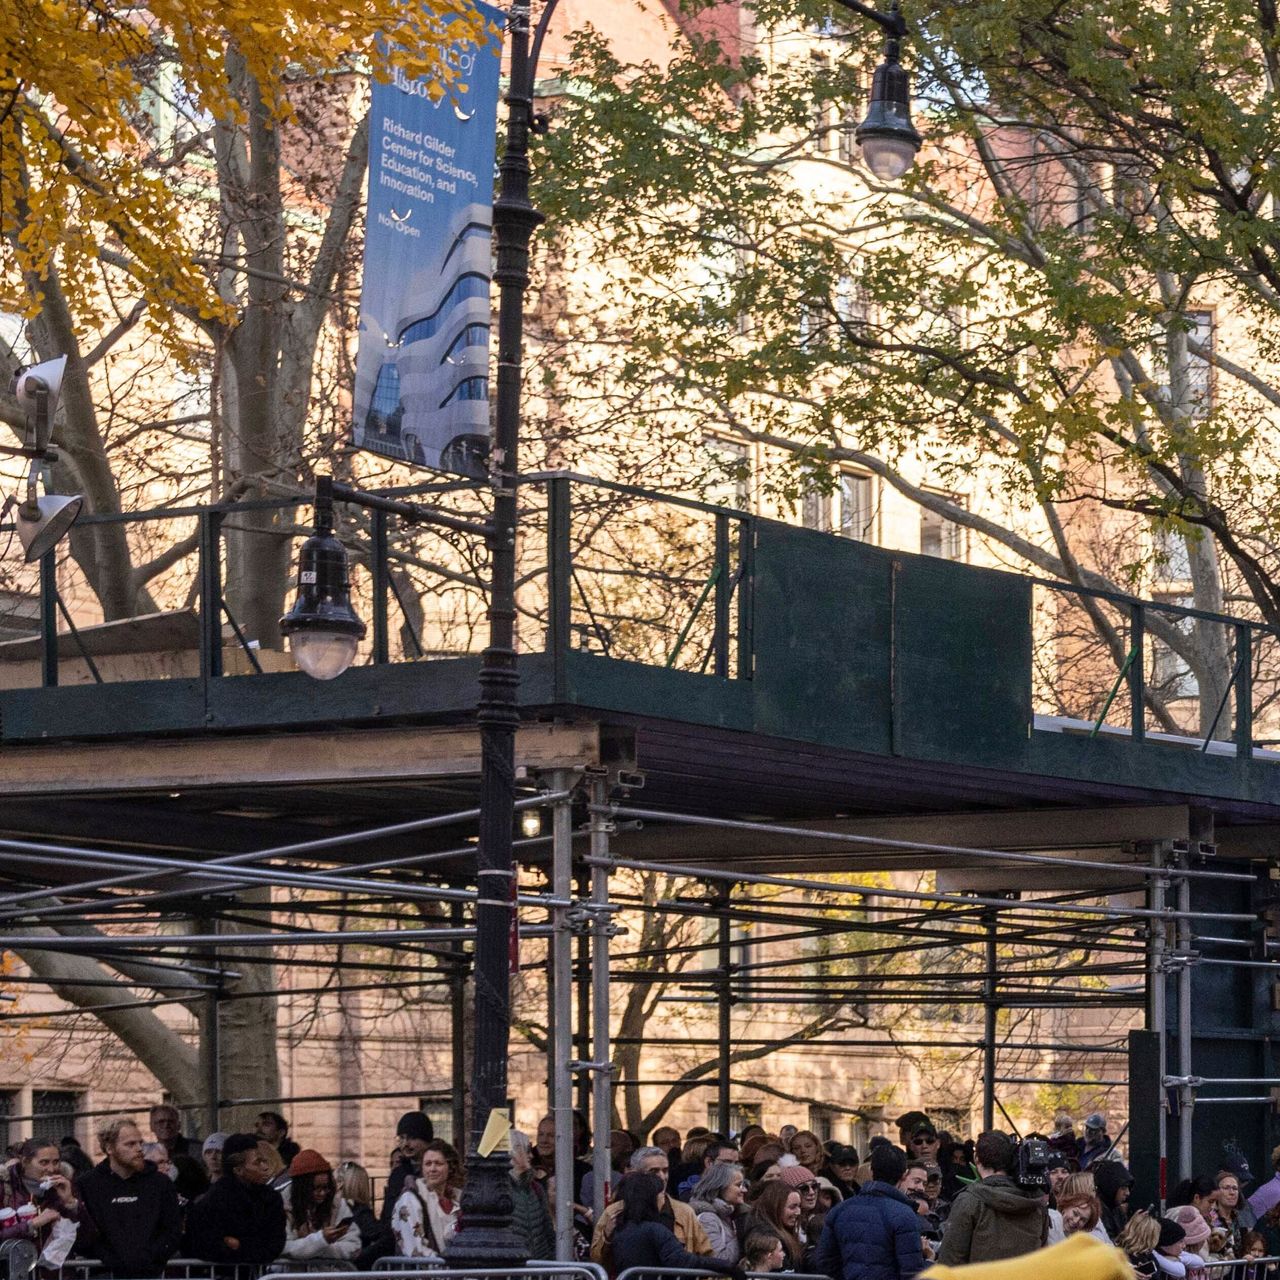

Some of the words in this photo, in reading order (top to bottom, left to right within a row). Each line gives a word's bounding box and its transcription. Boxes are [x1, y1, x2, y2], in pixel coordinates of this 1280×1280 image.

[382, 136, 417, 160] Center
[419, 150, 434, 166] for
[383, 117, 422, 144] Richard
[424, 135, 455, 158] Gilder
[380, 170, 434, 203] Innovation
[381, 153, 435, 188] Education,
[436, 178, 457, 194] and
[394, 220, 420, 237] Open
